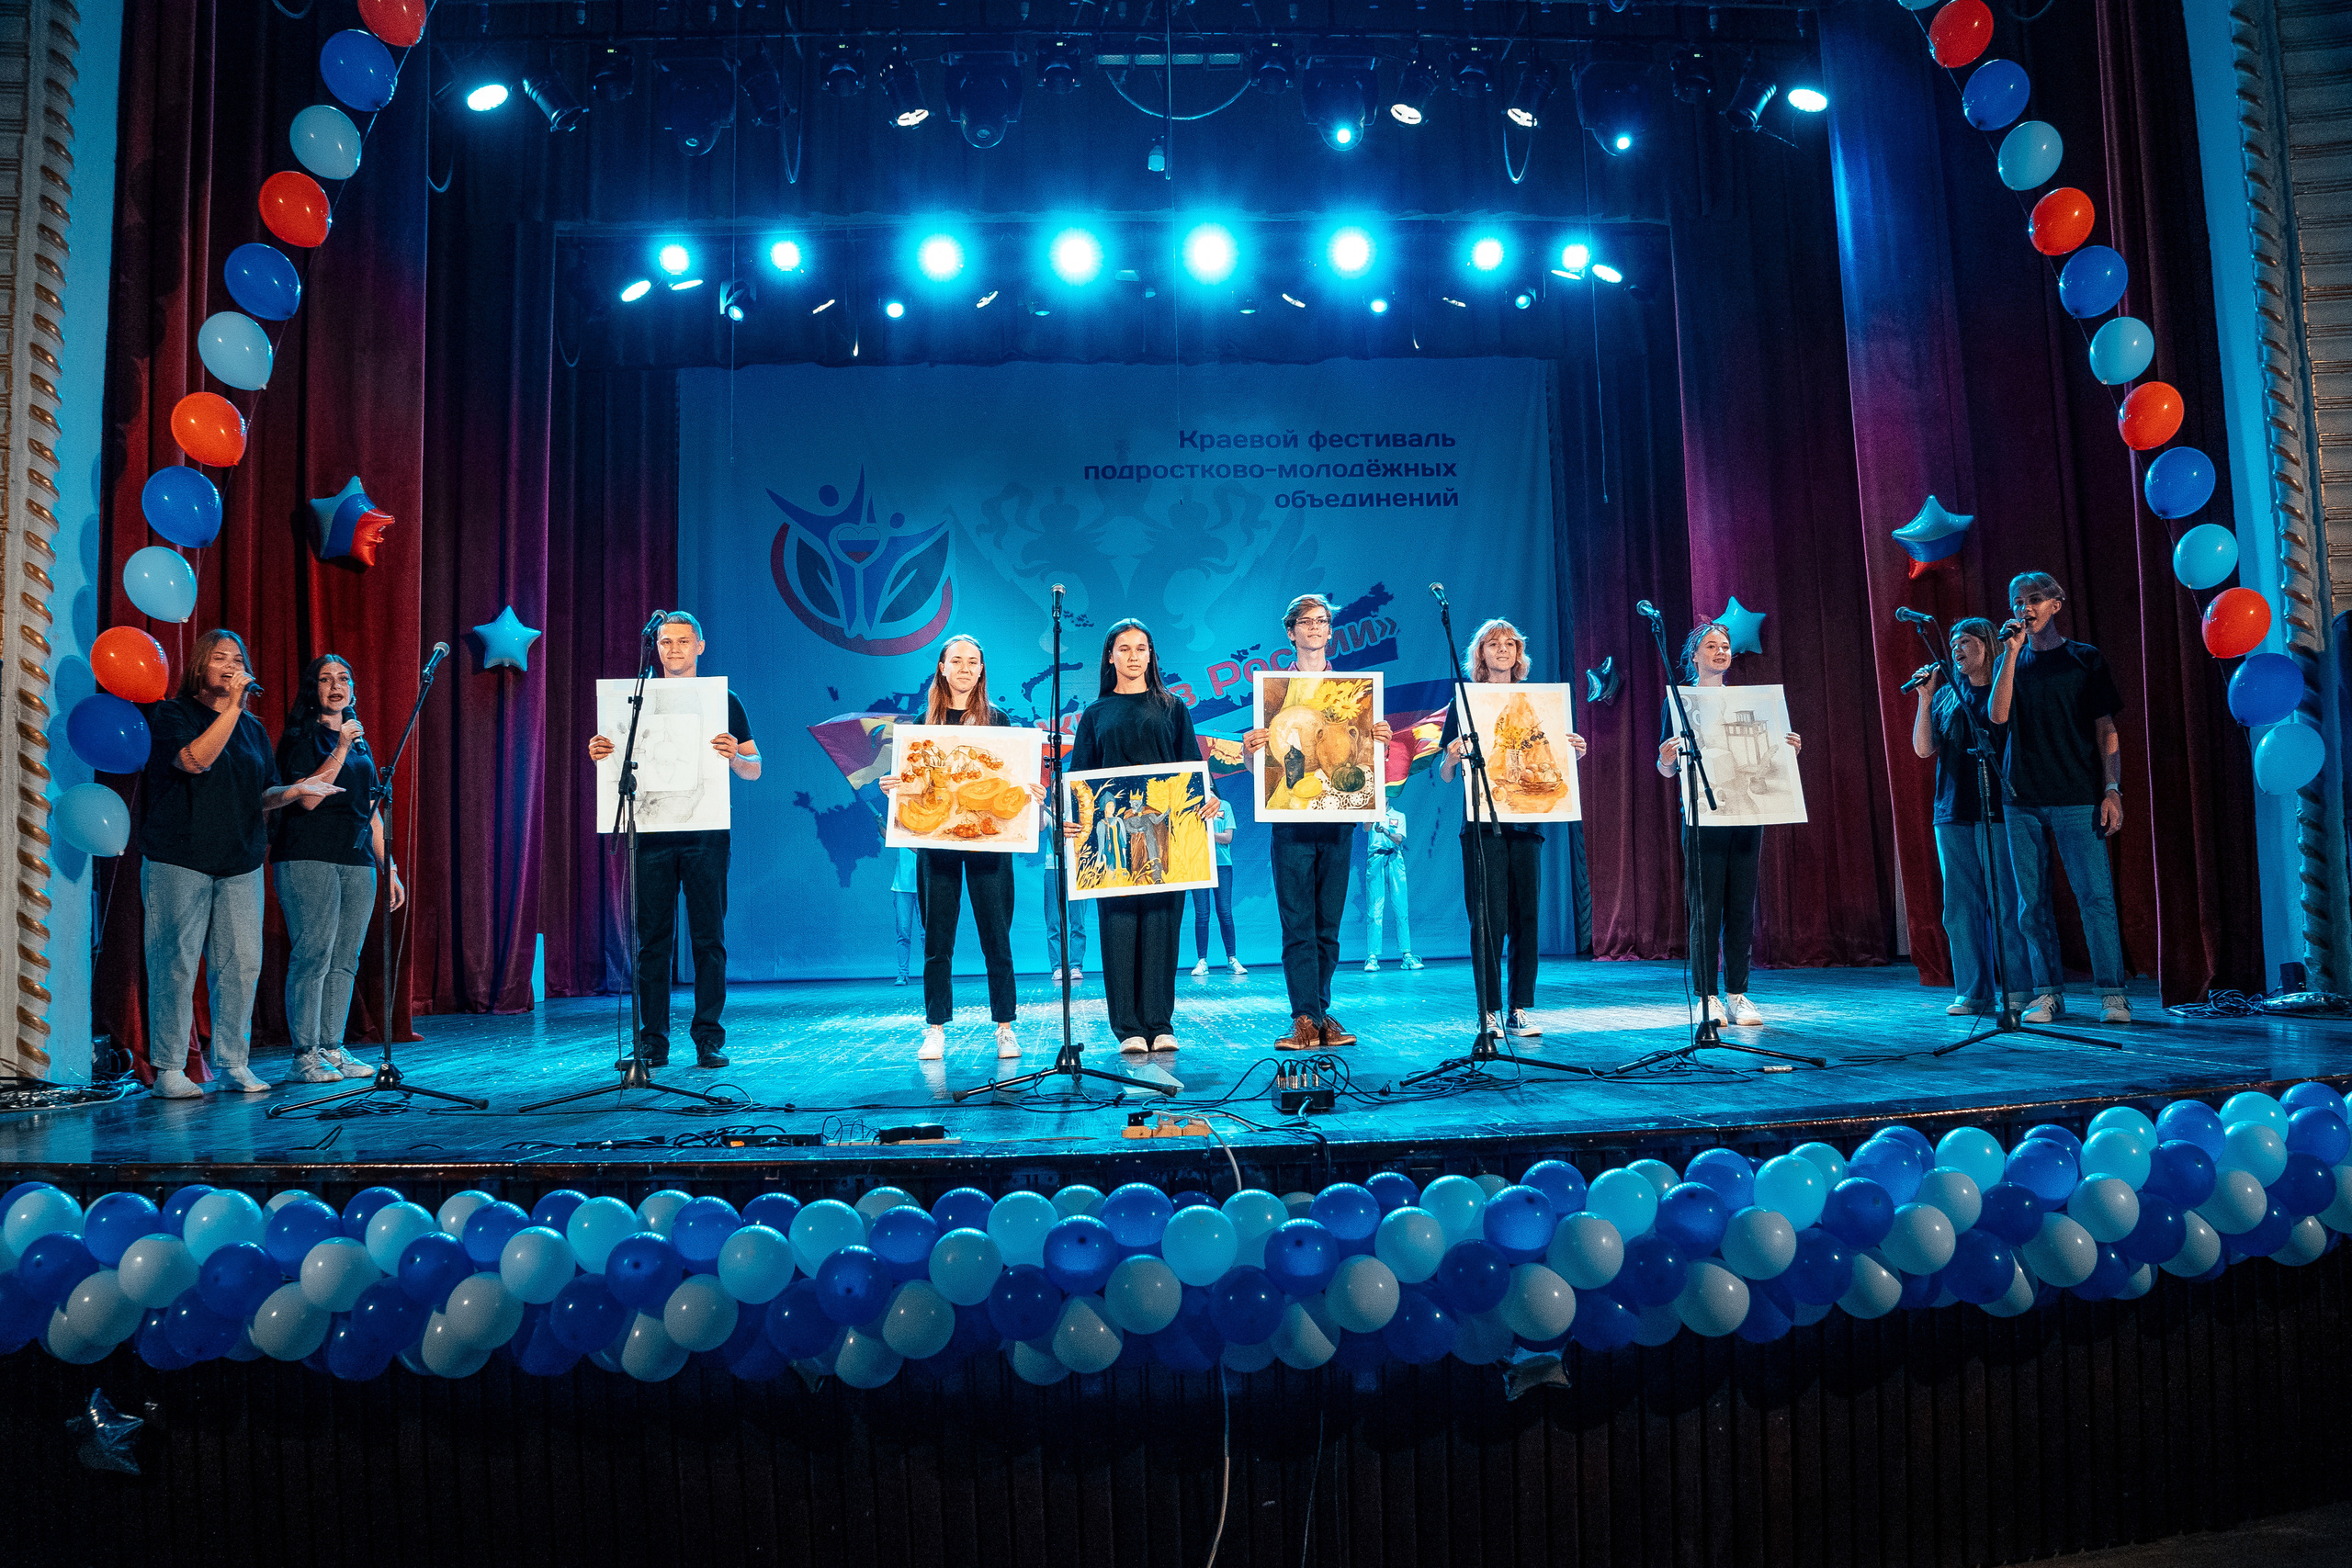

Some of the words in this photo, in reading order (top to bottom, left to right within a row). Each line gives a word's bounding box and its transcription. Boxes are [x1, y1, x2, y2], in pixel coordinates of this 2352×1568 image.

[1179, 429, 1298, 452] Краевой
[1307, 430, 1457, 452] фестиваль
[1083, 459, 1458, 483] подростково-молодёжных
[1274, 487, 1460, 509] объединений
[1206, 616, 1396, 697] Росии»
